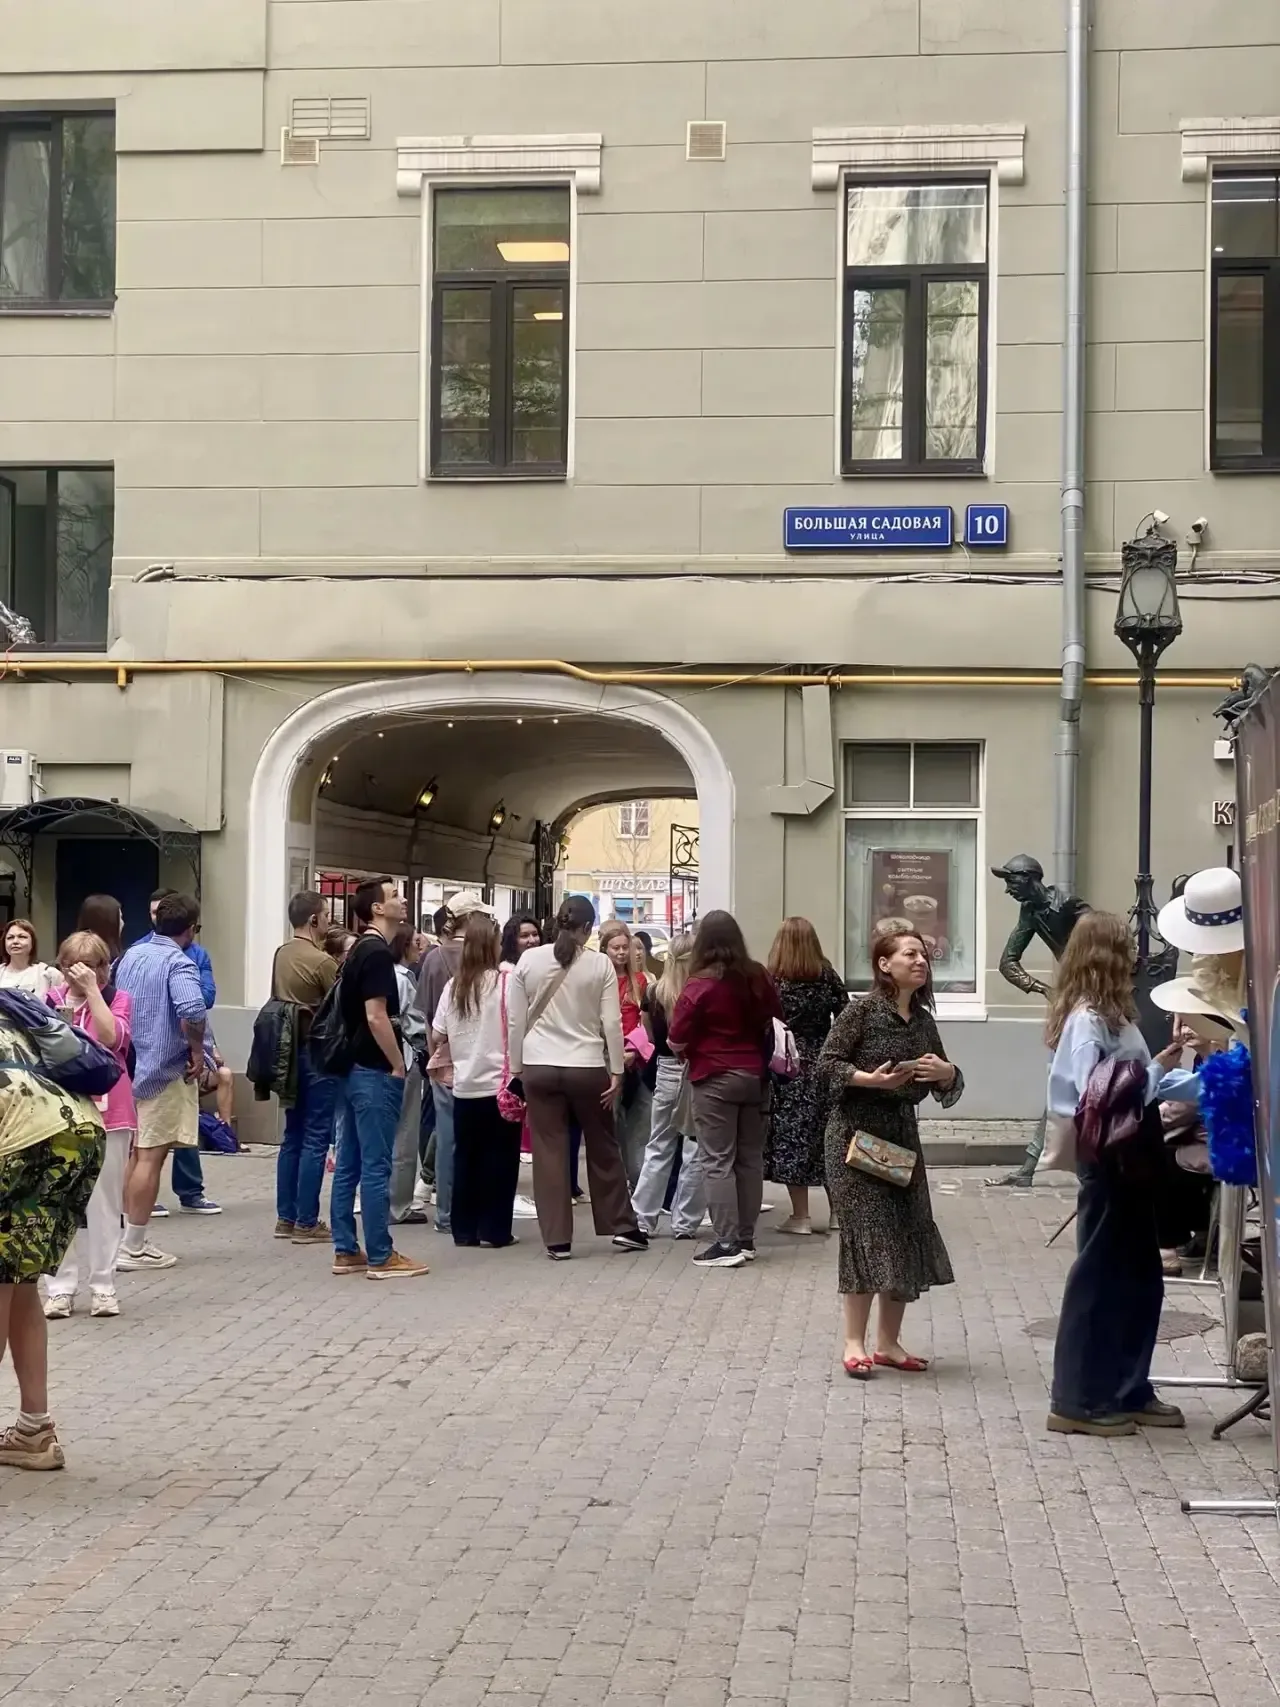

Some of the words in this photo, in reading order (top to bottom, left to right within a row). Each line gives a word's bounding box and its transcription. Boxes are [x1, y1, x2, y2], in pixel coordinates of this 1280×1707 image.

[794, 516, 867, 531] БОЛЬШАЯ
[871, 515, 942, 531] САДОВАЯ
[974, 515, 1000, 535] 10
[850, 533, 885, 541] УЛИЦА
